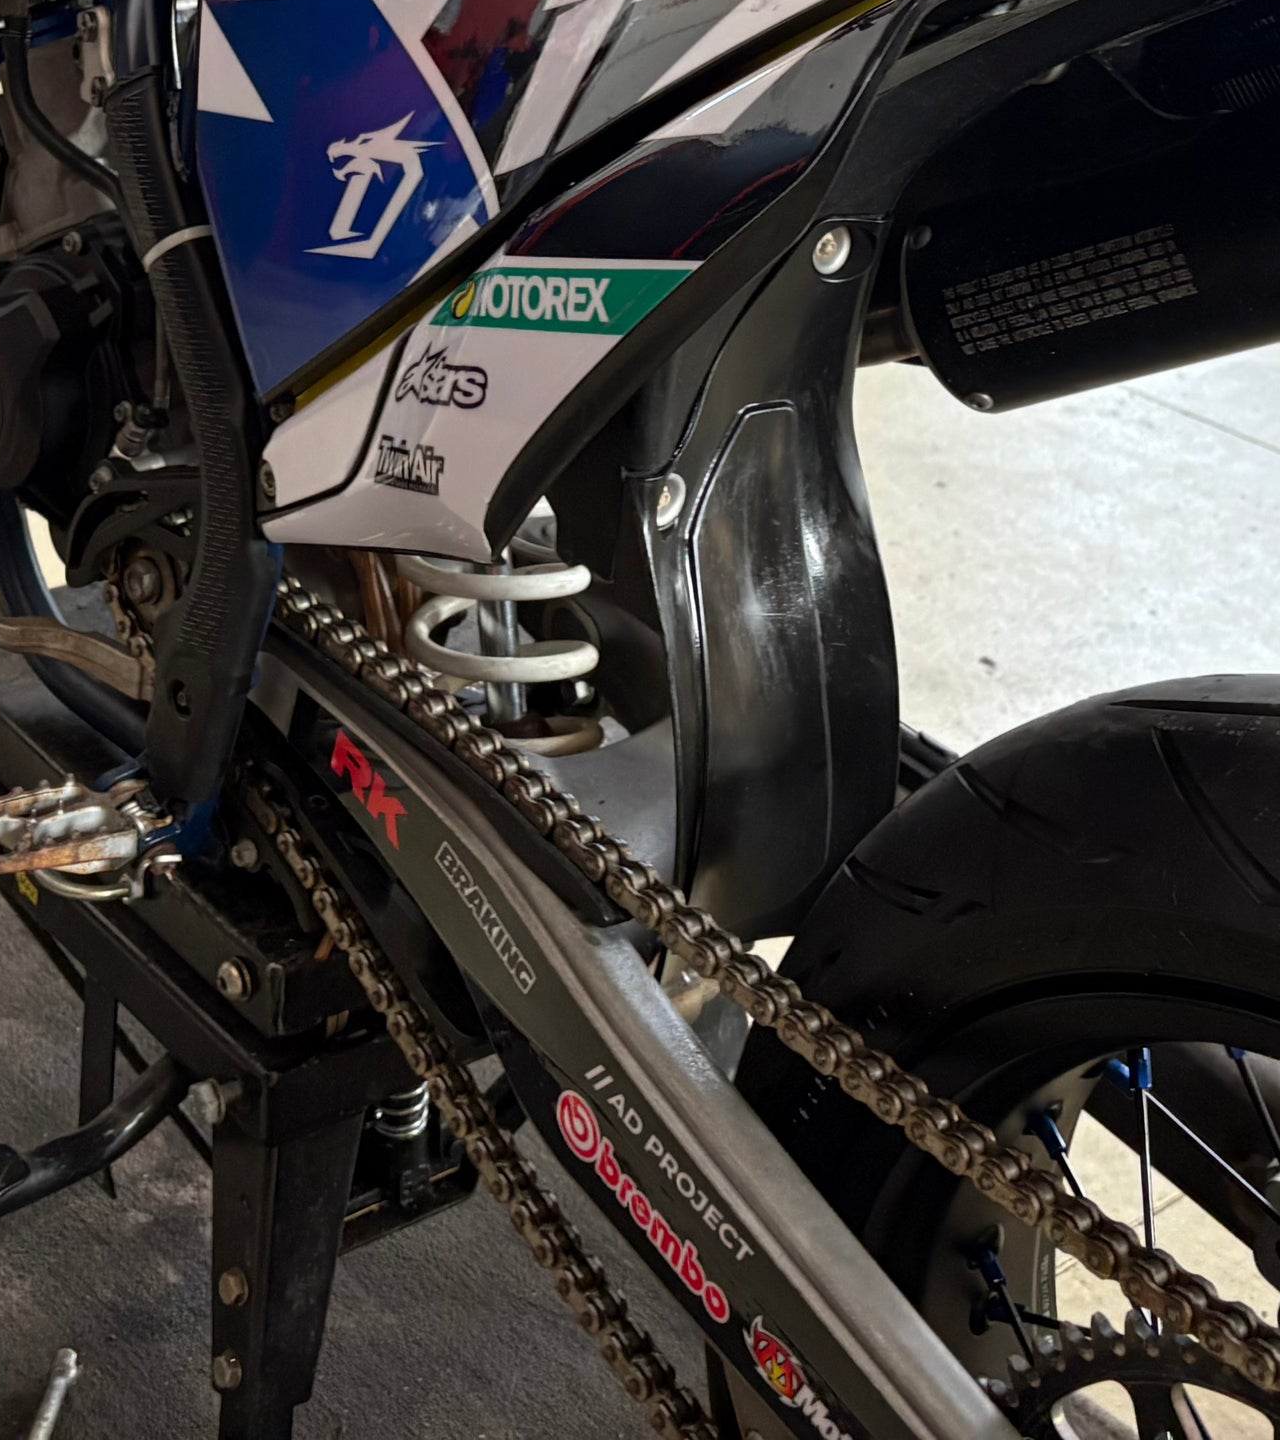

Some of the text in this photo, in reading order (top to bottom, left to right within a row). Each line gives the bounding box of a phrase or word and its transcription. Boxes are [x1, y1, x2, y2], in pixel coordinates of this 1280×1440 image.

[330, 728, 409, 852] RK
[435, 841, 536, 994] BRAKING
[594, 1135, 730, 1324] brembo
[644, 1133, 755, 1261] PROJECT
